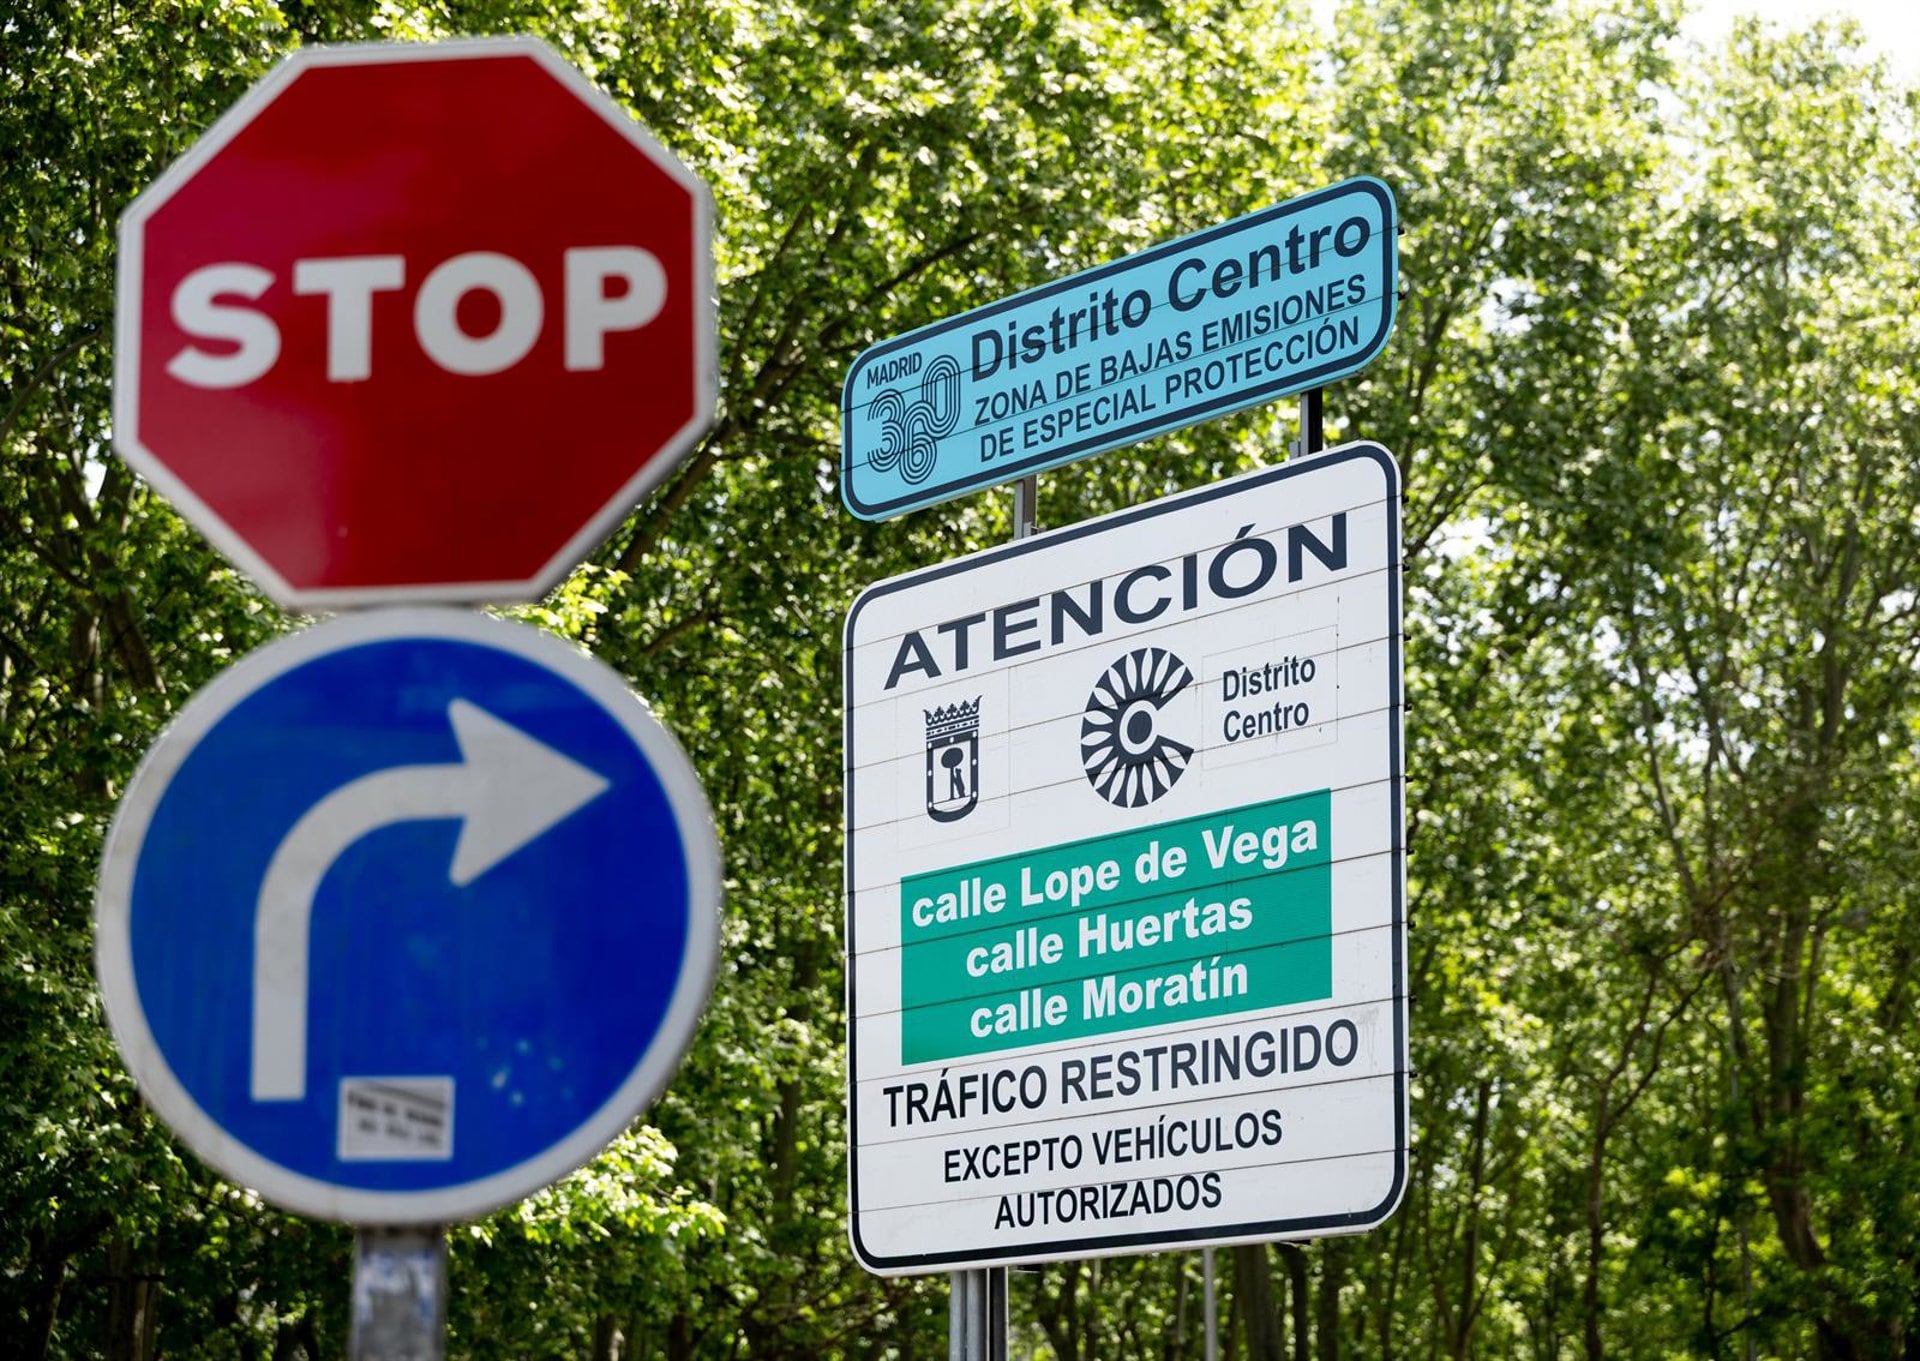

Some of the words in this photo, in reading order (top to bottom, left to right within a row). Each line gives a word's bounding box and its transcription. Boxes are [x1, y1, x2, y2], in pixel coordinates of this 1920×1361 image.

[166, 245, 668, 389] STOP
[972, 287, 1151, 382] Distrito
[1168, 216, 1370, 312] Centro
[975, 378, 1047, 427] ZONA
[1056, 363, 1091, 399] DE
[1101, 331, 1192, 384] BAJAS
[1202, 274, 1366, 354] EMISIONES
[867, 352, 922, 389] MADRID
[867, 354, 961, 486] 360
[981, 426, 1014, 462] DE
[1024, 385, 1156, 448] ESPECIAL
[1166, 316, 1359, 404] PROTECCIÓN
[883, 511, 1347, 690] ATENCIÓN
[1223, 657, 1316, 702] Distrito
[1223, 699, 1309, 742] Centro
[912, 877, 1005, 928] calle
[1020, 859, 1120, 907] Lope
[1135, 841, 1187, 884] de
[1201, 819, 1317, 870] Vega
[966, 927, 1063, 977] calle
[1078, 897, 1254, 957] Huertas
[970, 988, 1067, 1038] calle
[1082, 957, 1248, 1020] Moratín
[883, 1065, 1047, 1128] TRÁFICO
[1061, 1018, 1358, 1104] RESTRINGIDO
[944, 1134, 1082, 1183] EXCEPTO
[1092, 1109, 1283, 1165] VEHÍCULOS
[994, 1172, 1222, 1230] AUTORIZADOS
